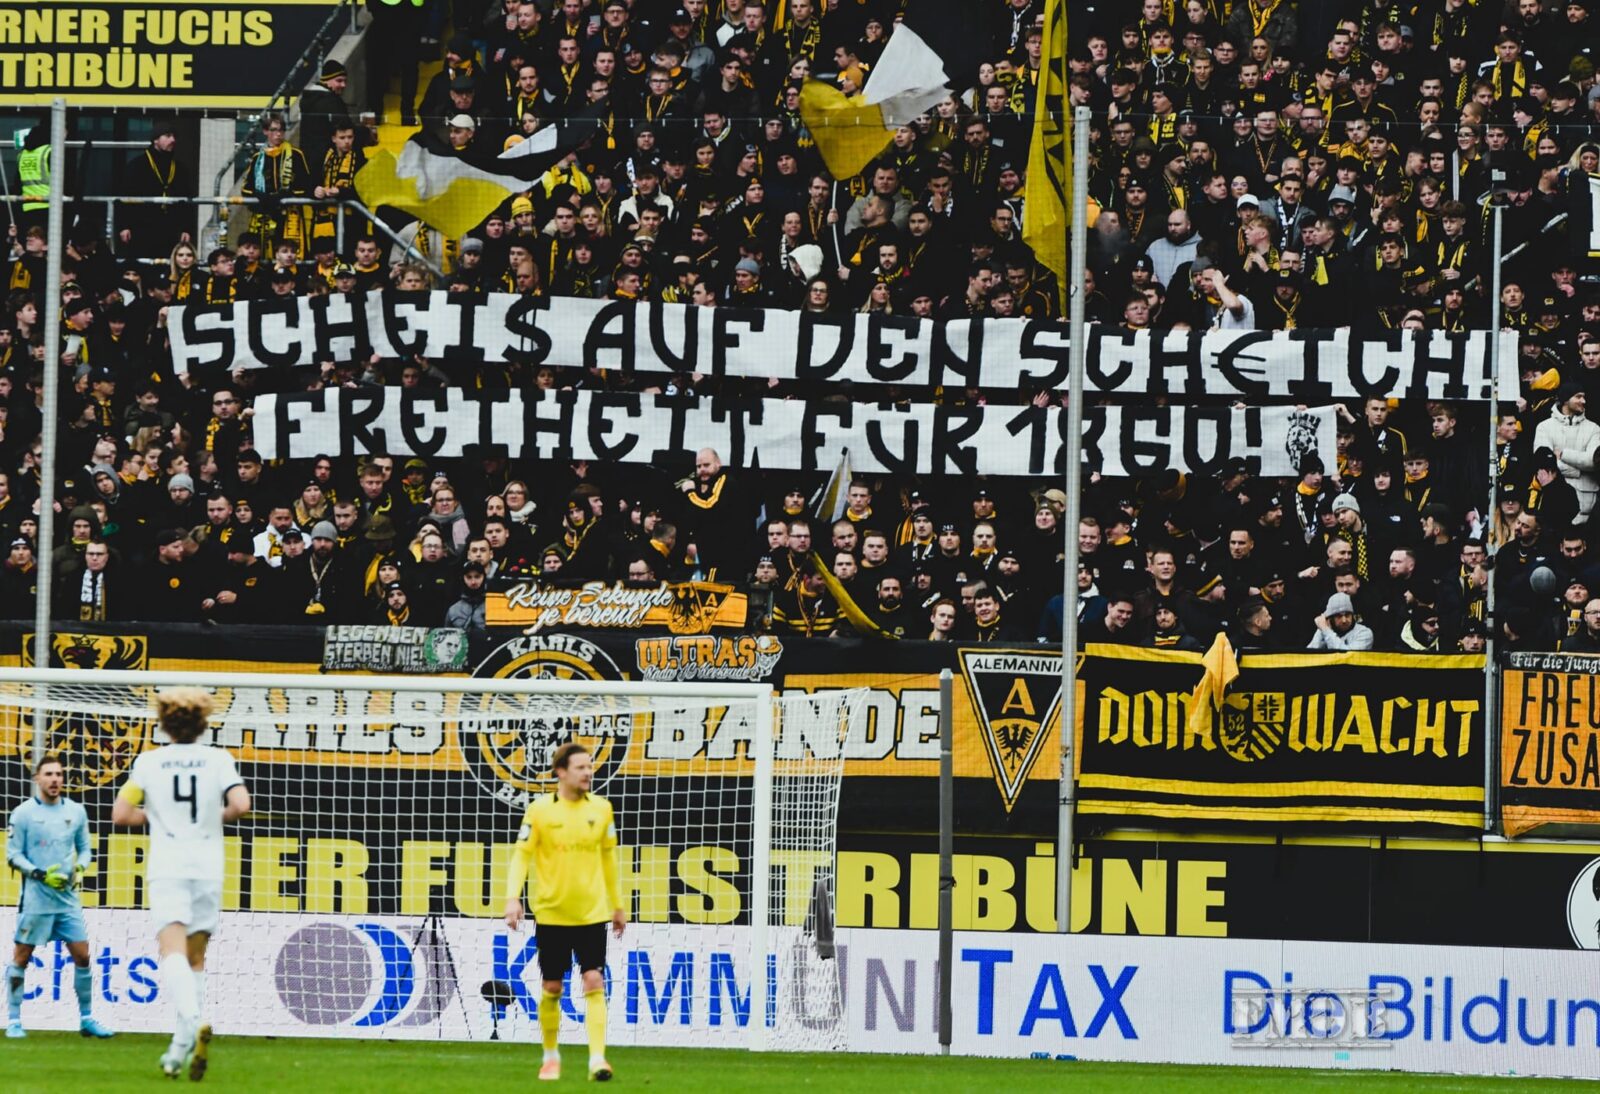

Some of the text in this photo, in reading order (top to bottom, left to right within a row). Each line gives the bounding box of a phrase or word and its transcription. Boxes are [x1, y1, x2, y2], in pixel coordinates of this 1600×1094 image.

[123, 10, 273, 46] FUCHS
[0, 47, 193, 88] TRIBÜNE
[583, 300, 765, 375] AUF
[799, 310, 985, 388] DEN
[275, 386, 763, 468] FREIHEIT
[801, 400, 985, 476] FÜR
[505, 583, 572, 608] Keine
[327, 625, 428, 643] LEGENDEN
[523, 606, 561, 634] je
[325, 642, 425, 666] STERBEN NIE!
[506, 635, 596, 663] KARLS
[637, 637, 758, 669] ULTRAS
[1510, 652, 1537, 668] Für
[1542, 652, 1563, 669] die
[1001, 678, 1036, 716] A
[152, 685, 446, 754] ARLS
[1228, 713, 1245, 731] 52
[1288, 694, 1480, 758] WACHT
[1509, 729, 1600, 787] ZUSA
[173, 774, 197, 824] 4
[402, 840, 741, 924] FUHS
[769, 840, 1227, 937] TRIBÜNE
